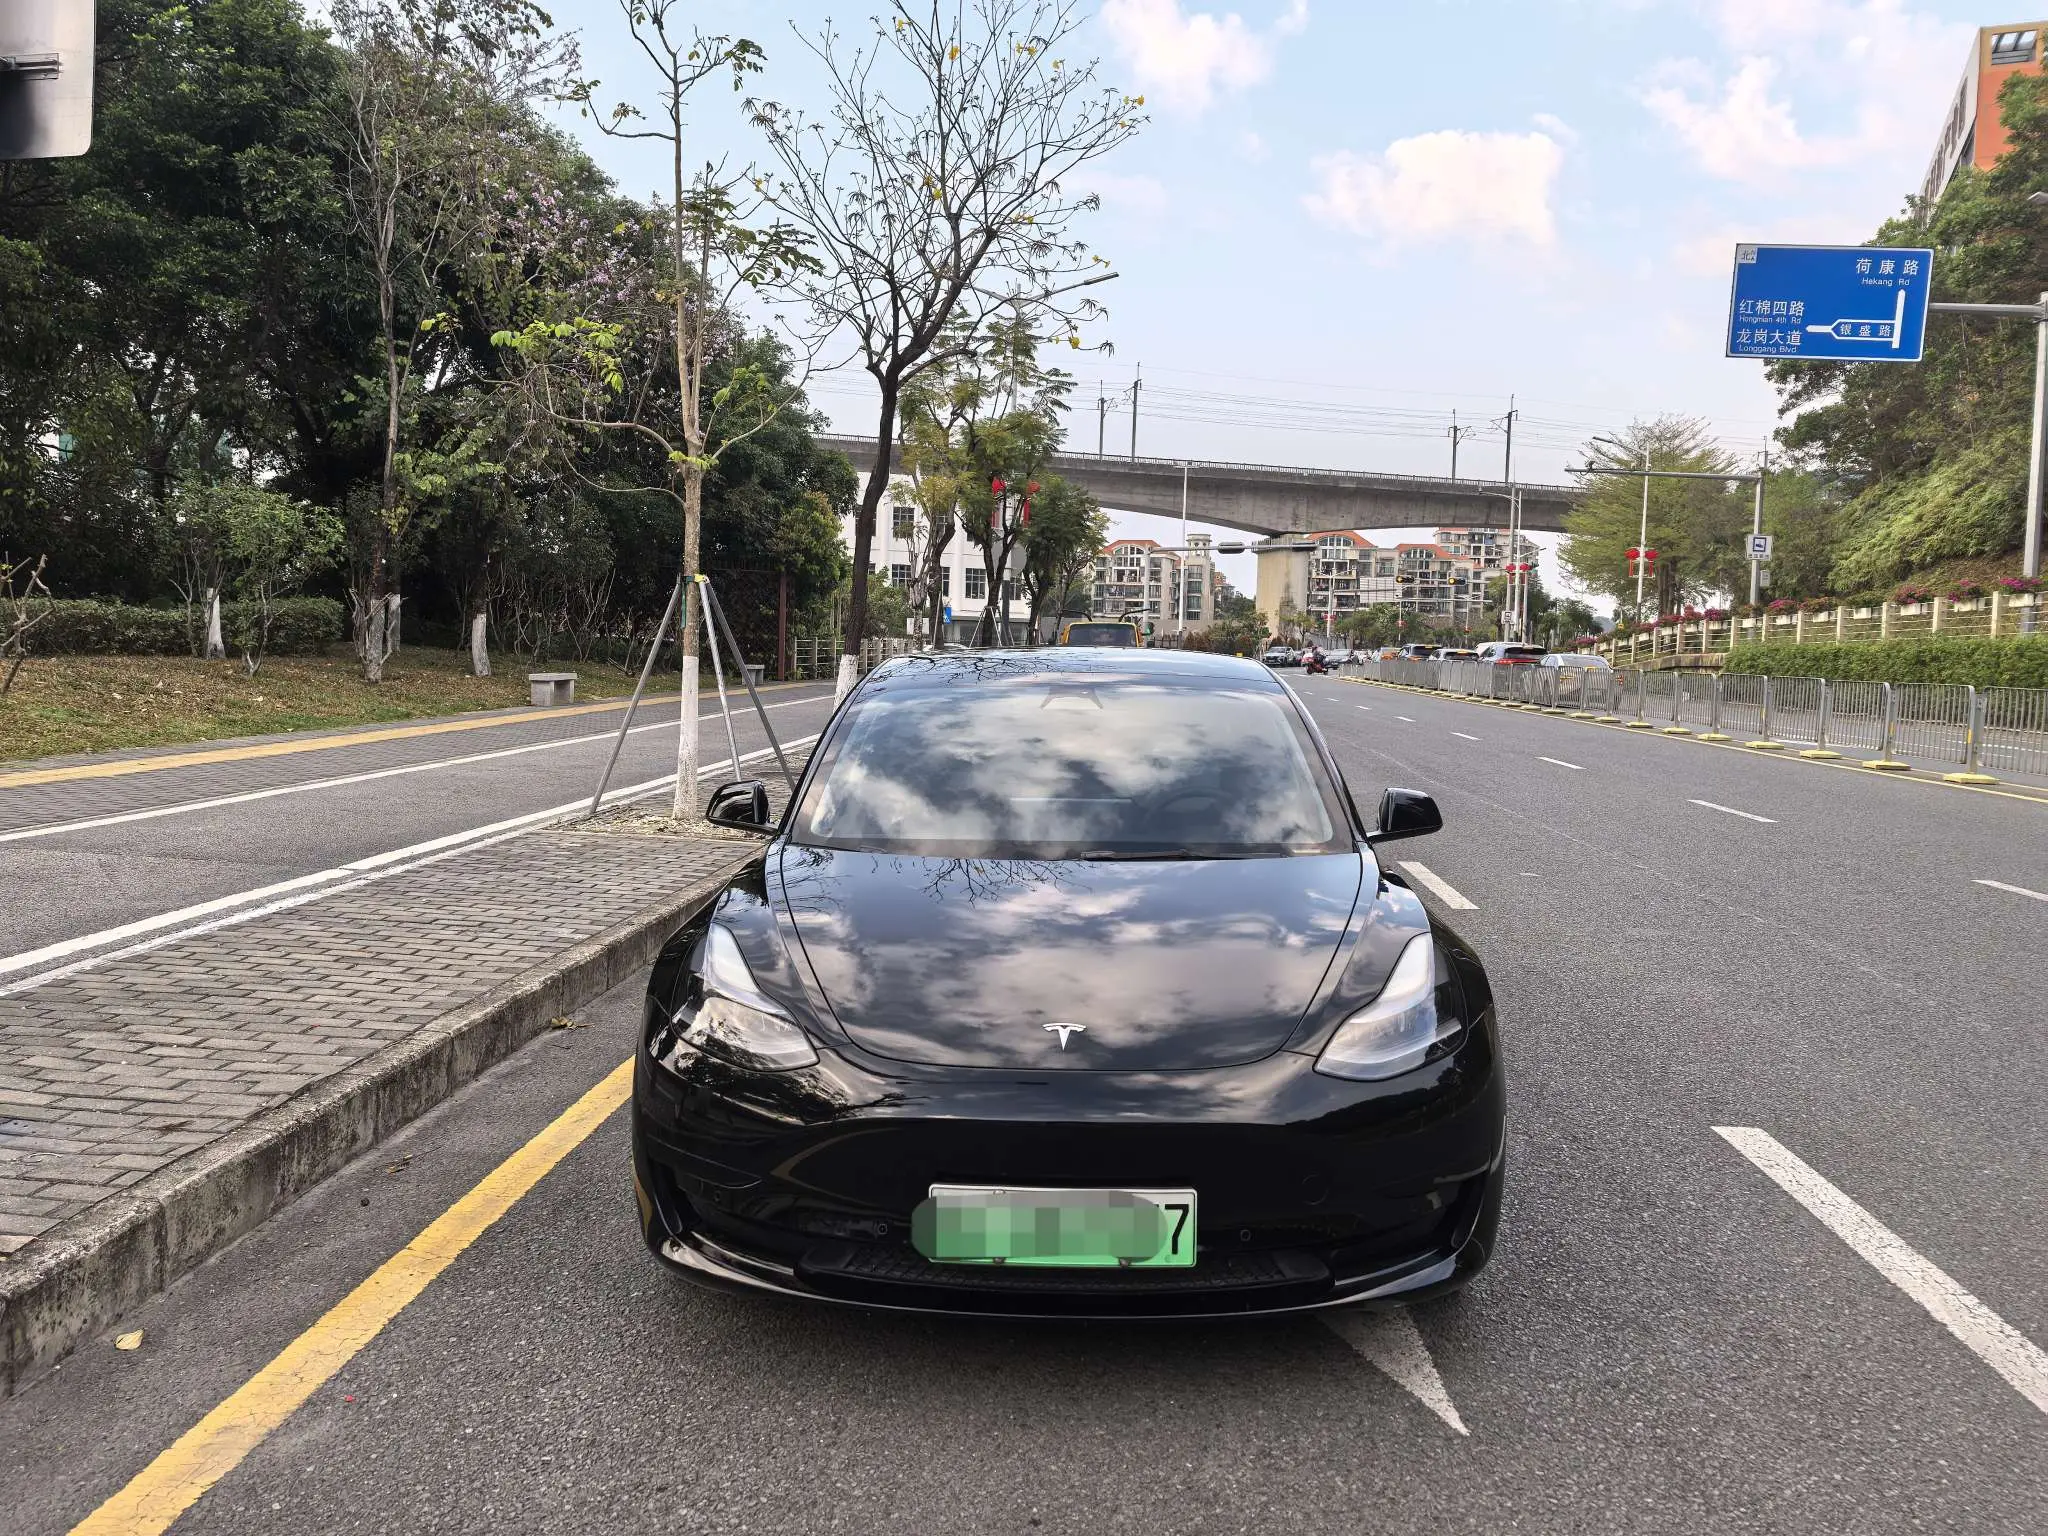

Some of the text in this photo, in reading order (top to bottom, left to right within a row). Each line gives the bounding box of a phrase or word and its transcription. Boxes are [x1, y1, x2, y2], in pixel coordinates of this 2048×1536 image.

[1856, 258, 1919, 275] 荷康路
[1862, 278, 1892, 286] Hekang
[1739, 299, 1805, 316] 红棉四路
[1739, 316, 1772, 324] Hongmian
[1840, 323, 1892, 336] 银盛路
[1736, 329, 1803, 345] 龙岗大道
[1739, 345, 1777, 353] Longgang
